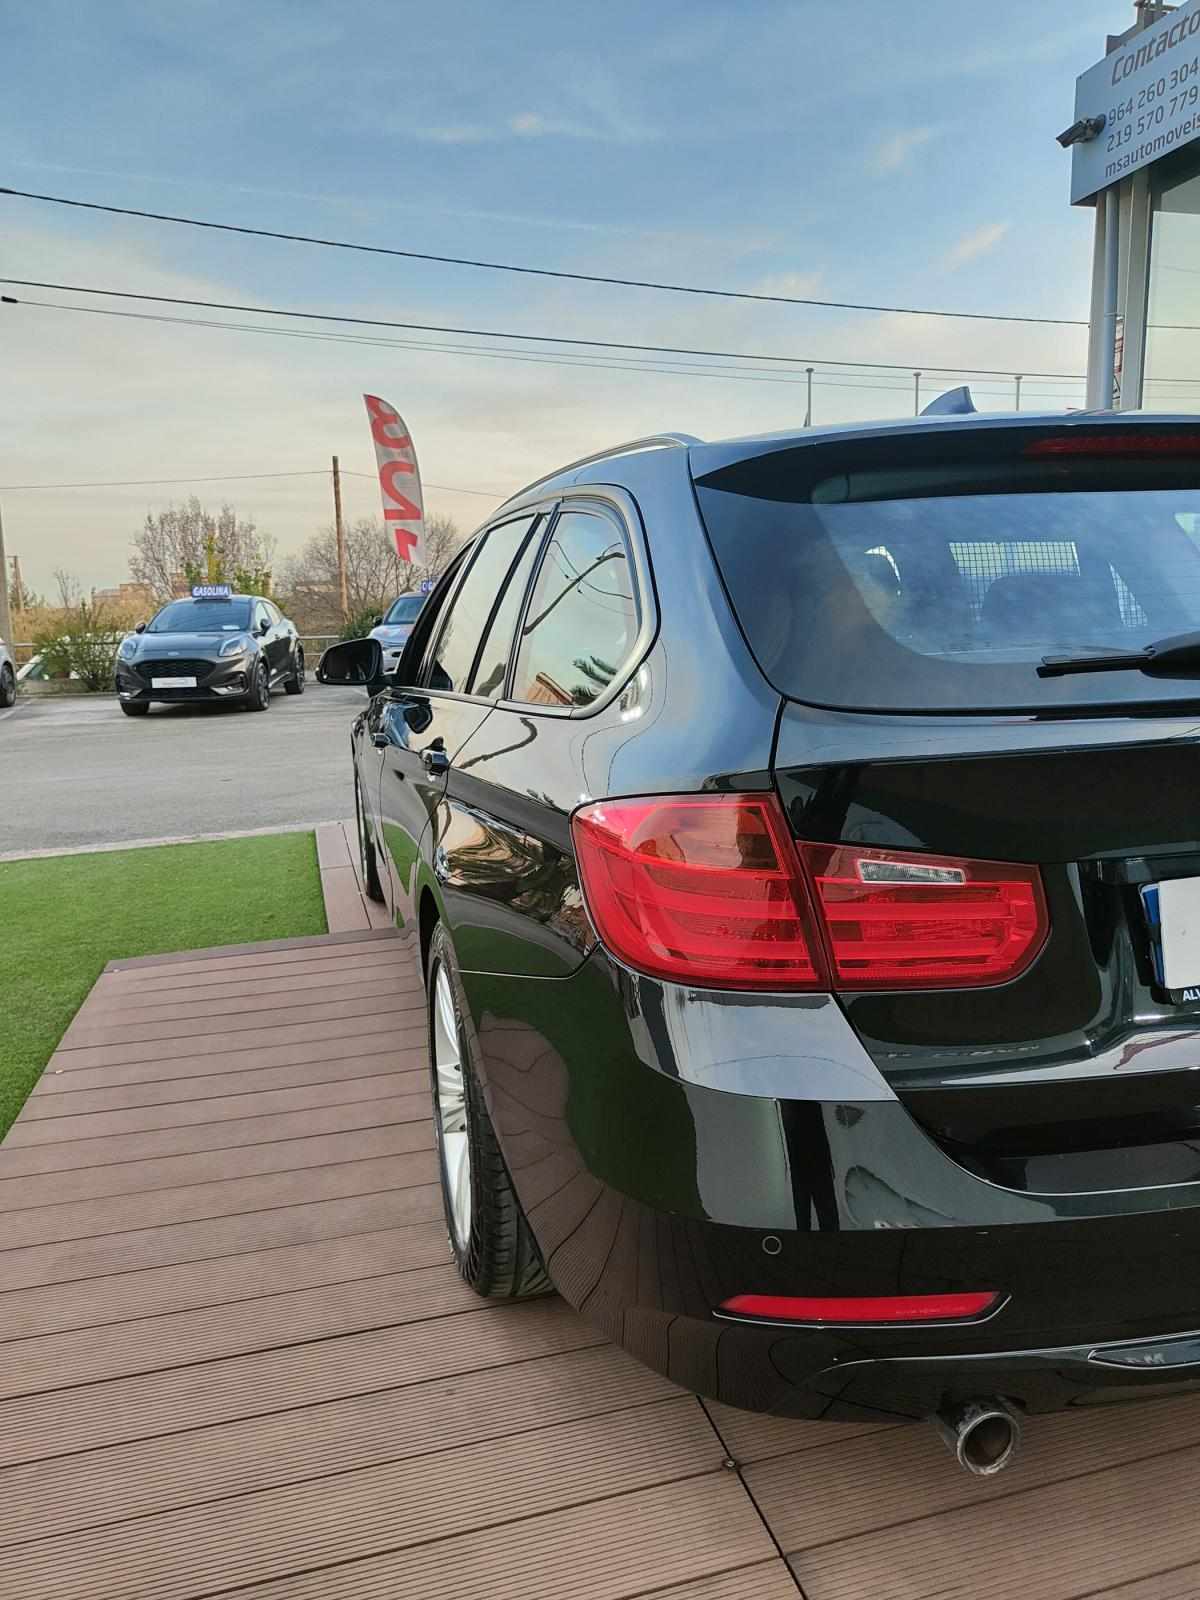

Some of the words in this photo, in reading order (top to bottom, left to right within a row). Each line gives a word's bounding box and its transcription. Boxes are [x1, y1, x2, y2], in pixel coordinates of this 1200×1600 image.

[1107, 124, 1132, 152] 219
[1137, 105, 1164, 135] 570
[1169, 85, 1198, 117] 779
[1108, 97, 1133, 127] 964
[1137, 78, 1165, 110] 260
[1169, 56, 1198, 90] 304
